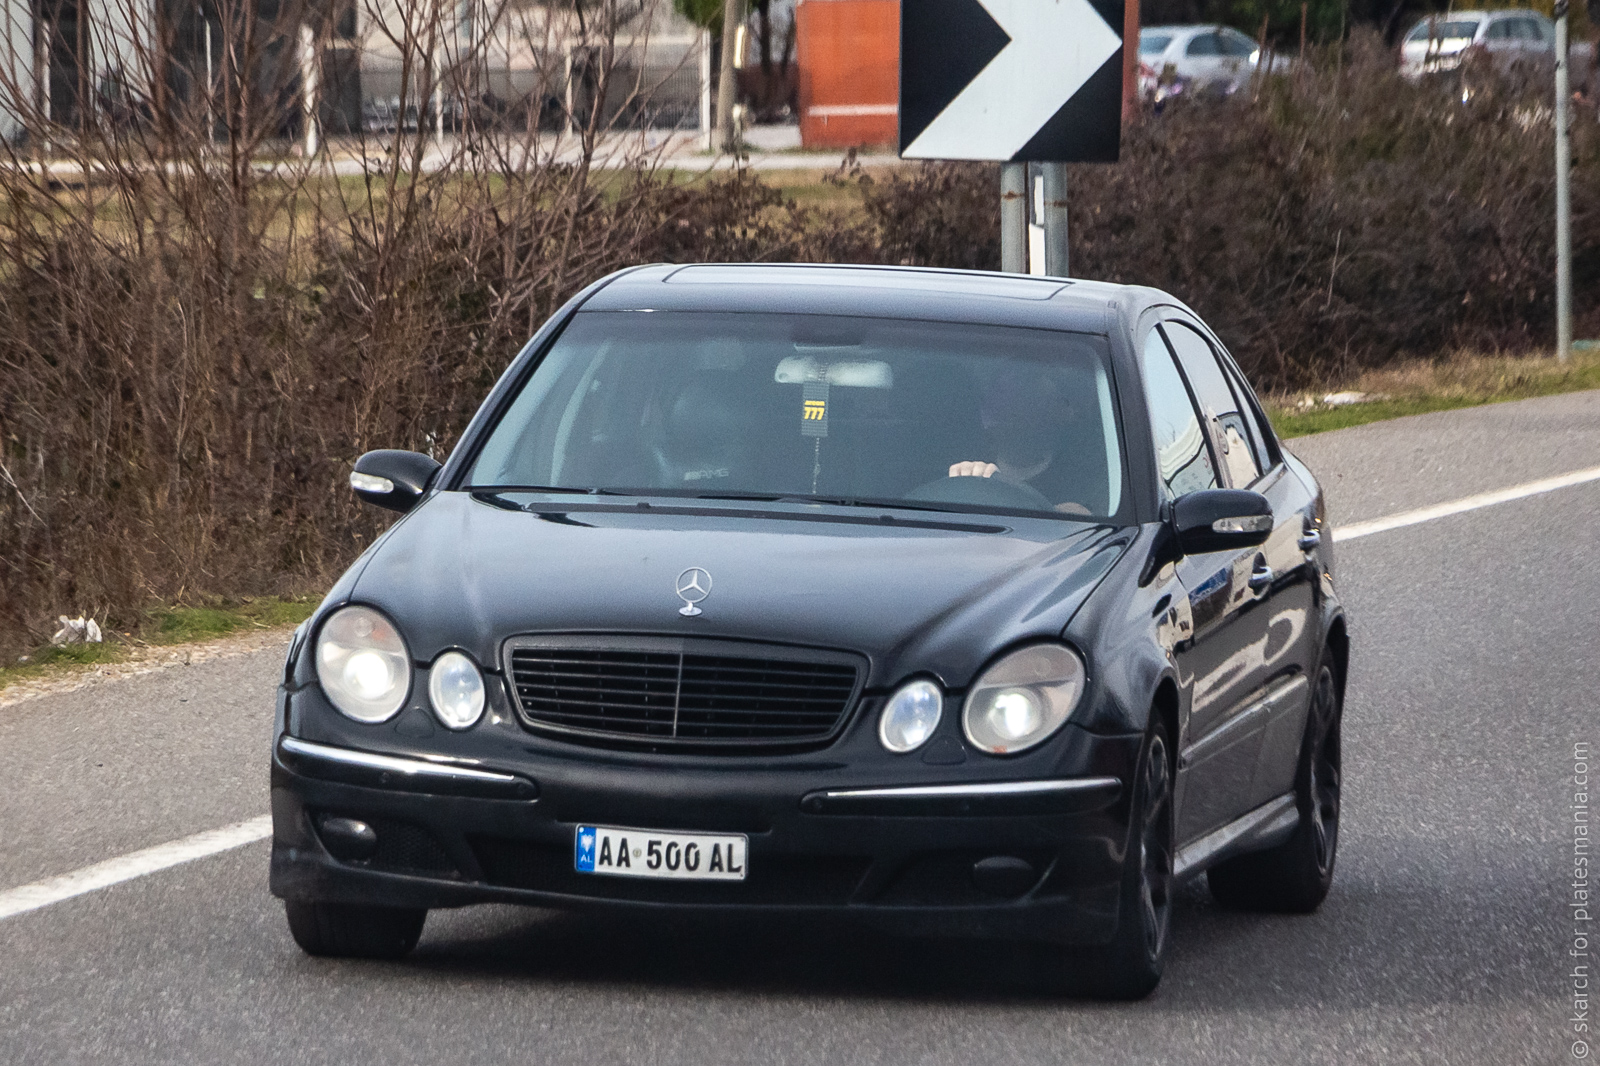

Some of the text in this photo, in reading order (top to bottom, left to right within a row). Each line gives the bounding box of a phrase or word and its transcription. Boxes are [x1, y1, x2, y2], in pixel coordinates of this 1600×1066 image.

[803, 407, 825, 420] 777
[580, 854, 593, 863] AL
[598, 836, 742, 873] AA 500 AL
